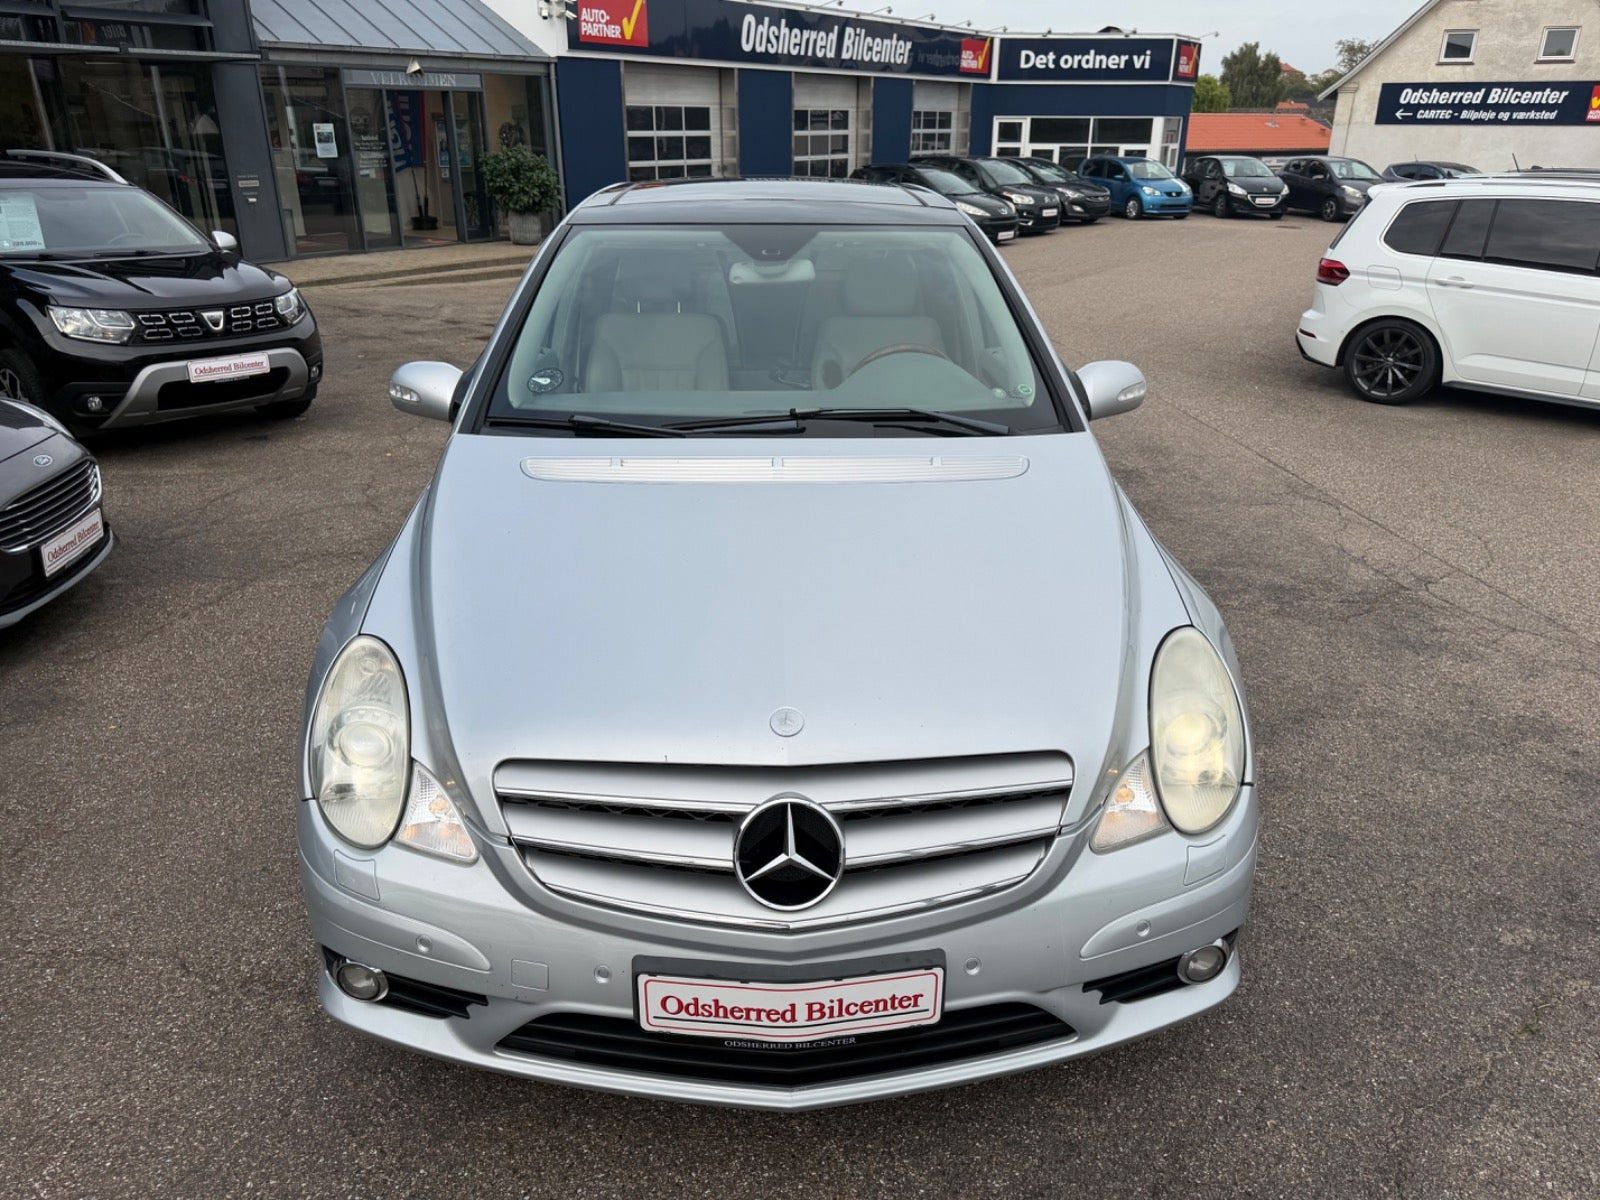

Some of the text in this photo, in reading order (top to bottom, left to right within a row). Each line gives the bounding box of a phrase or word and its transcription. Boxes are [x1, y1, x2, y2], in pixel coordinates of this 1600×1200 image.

[581, 8, 610, 23] AUTO-
[581, 23, 622, 39] PARTNER
[741, 13, 839, 58] Odsherred
[841, 26, 913, 65] Bilcenter
[1019, 49, 1151, 69] Det ordner vi
[1399, 88, 1569, 105] Odsherred Bilcenter
[1416, 109, 1453, 119] CARTEC
[1460, 109, 1496, 121] Bilpleje
[1497, 110, 1511, 121] og
[1512, 109, 1558, 120] værksted
[194, 360, 264, 375] Odsherred Bilcenter
[47, 536, 77, 562] Odsherred
[660, 992, 924, 1024] Odsherred Bilcenter
[724, 1036, 857, 1049] ODSHERRED BILCENTER
